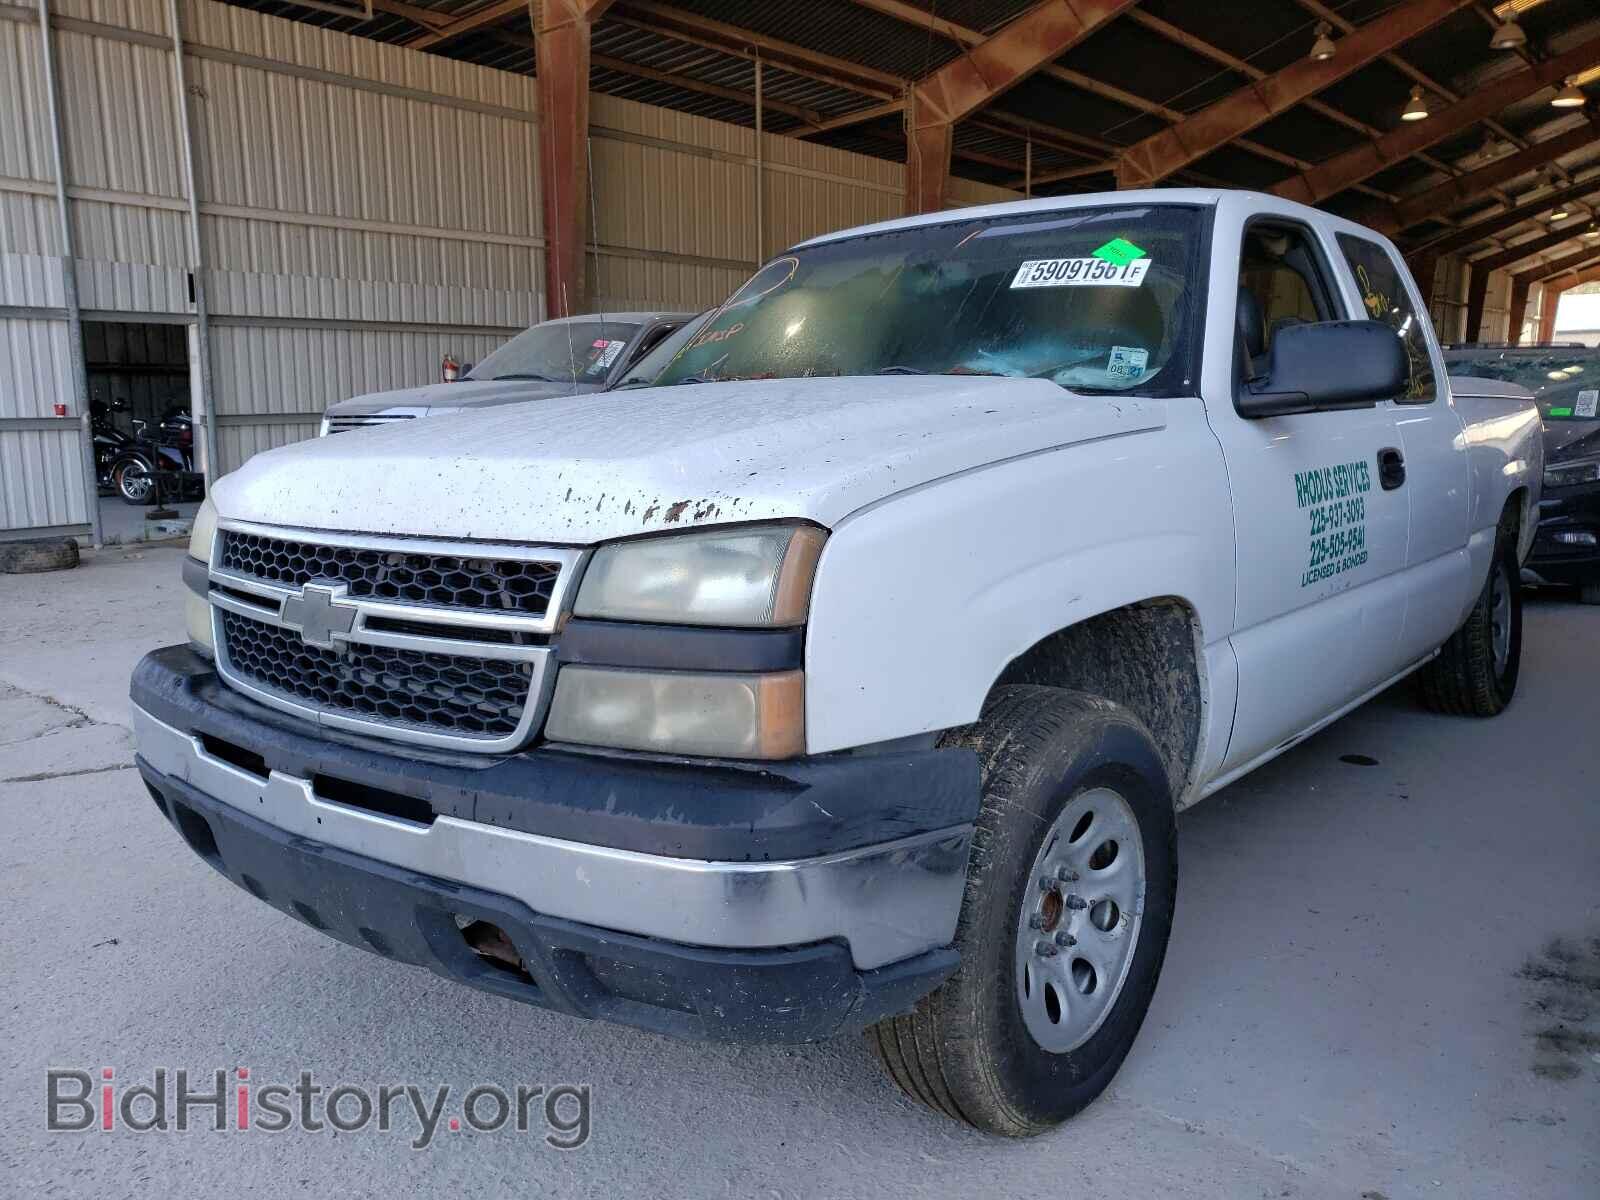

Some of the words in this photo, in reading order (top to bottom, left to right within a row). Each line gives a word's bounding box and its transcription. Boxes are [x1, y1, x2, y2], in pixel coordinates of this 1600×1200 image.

[1031, 260, 1130, 281] 59091561
[1295, 468, 1333, 508] RHODUS
[1333, 461, 1370, 498] SERVICES
[1310, 497, 1364, 535] 225-937-3093
[1309, 526, 1365, 567] 225-505-9541
[1301, 564, 1335, 587] LICENSED
[1335, 560, 1341, 574] &
[1342, 551, 1368, 571] BONDED
